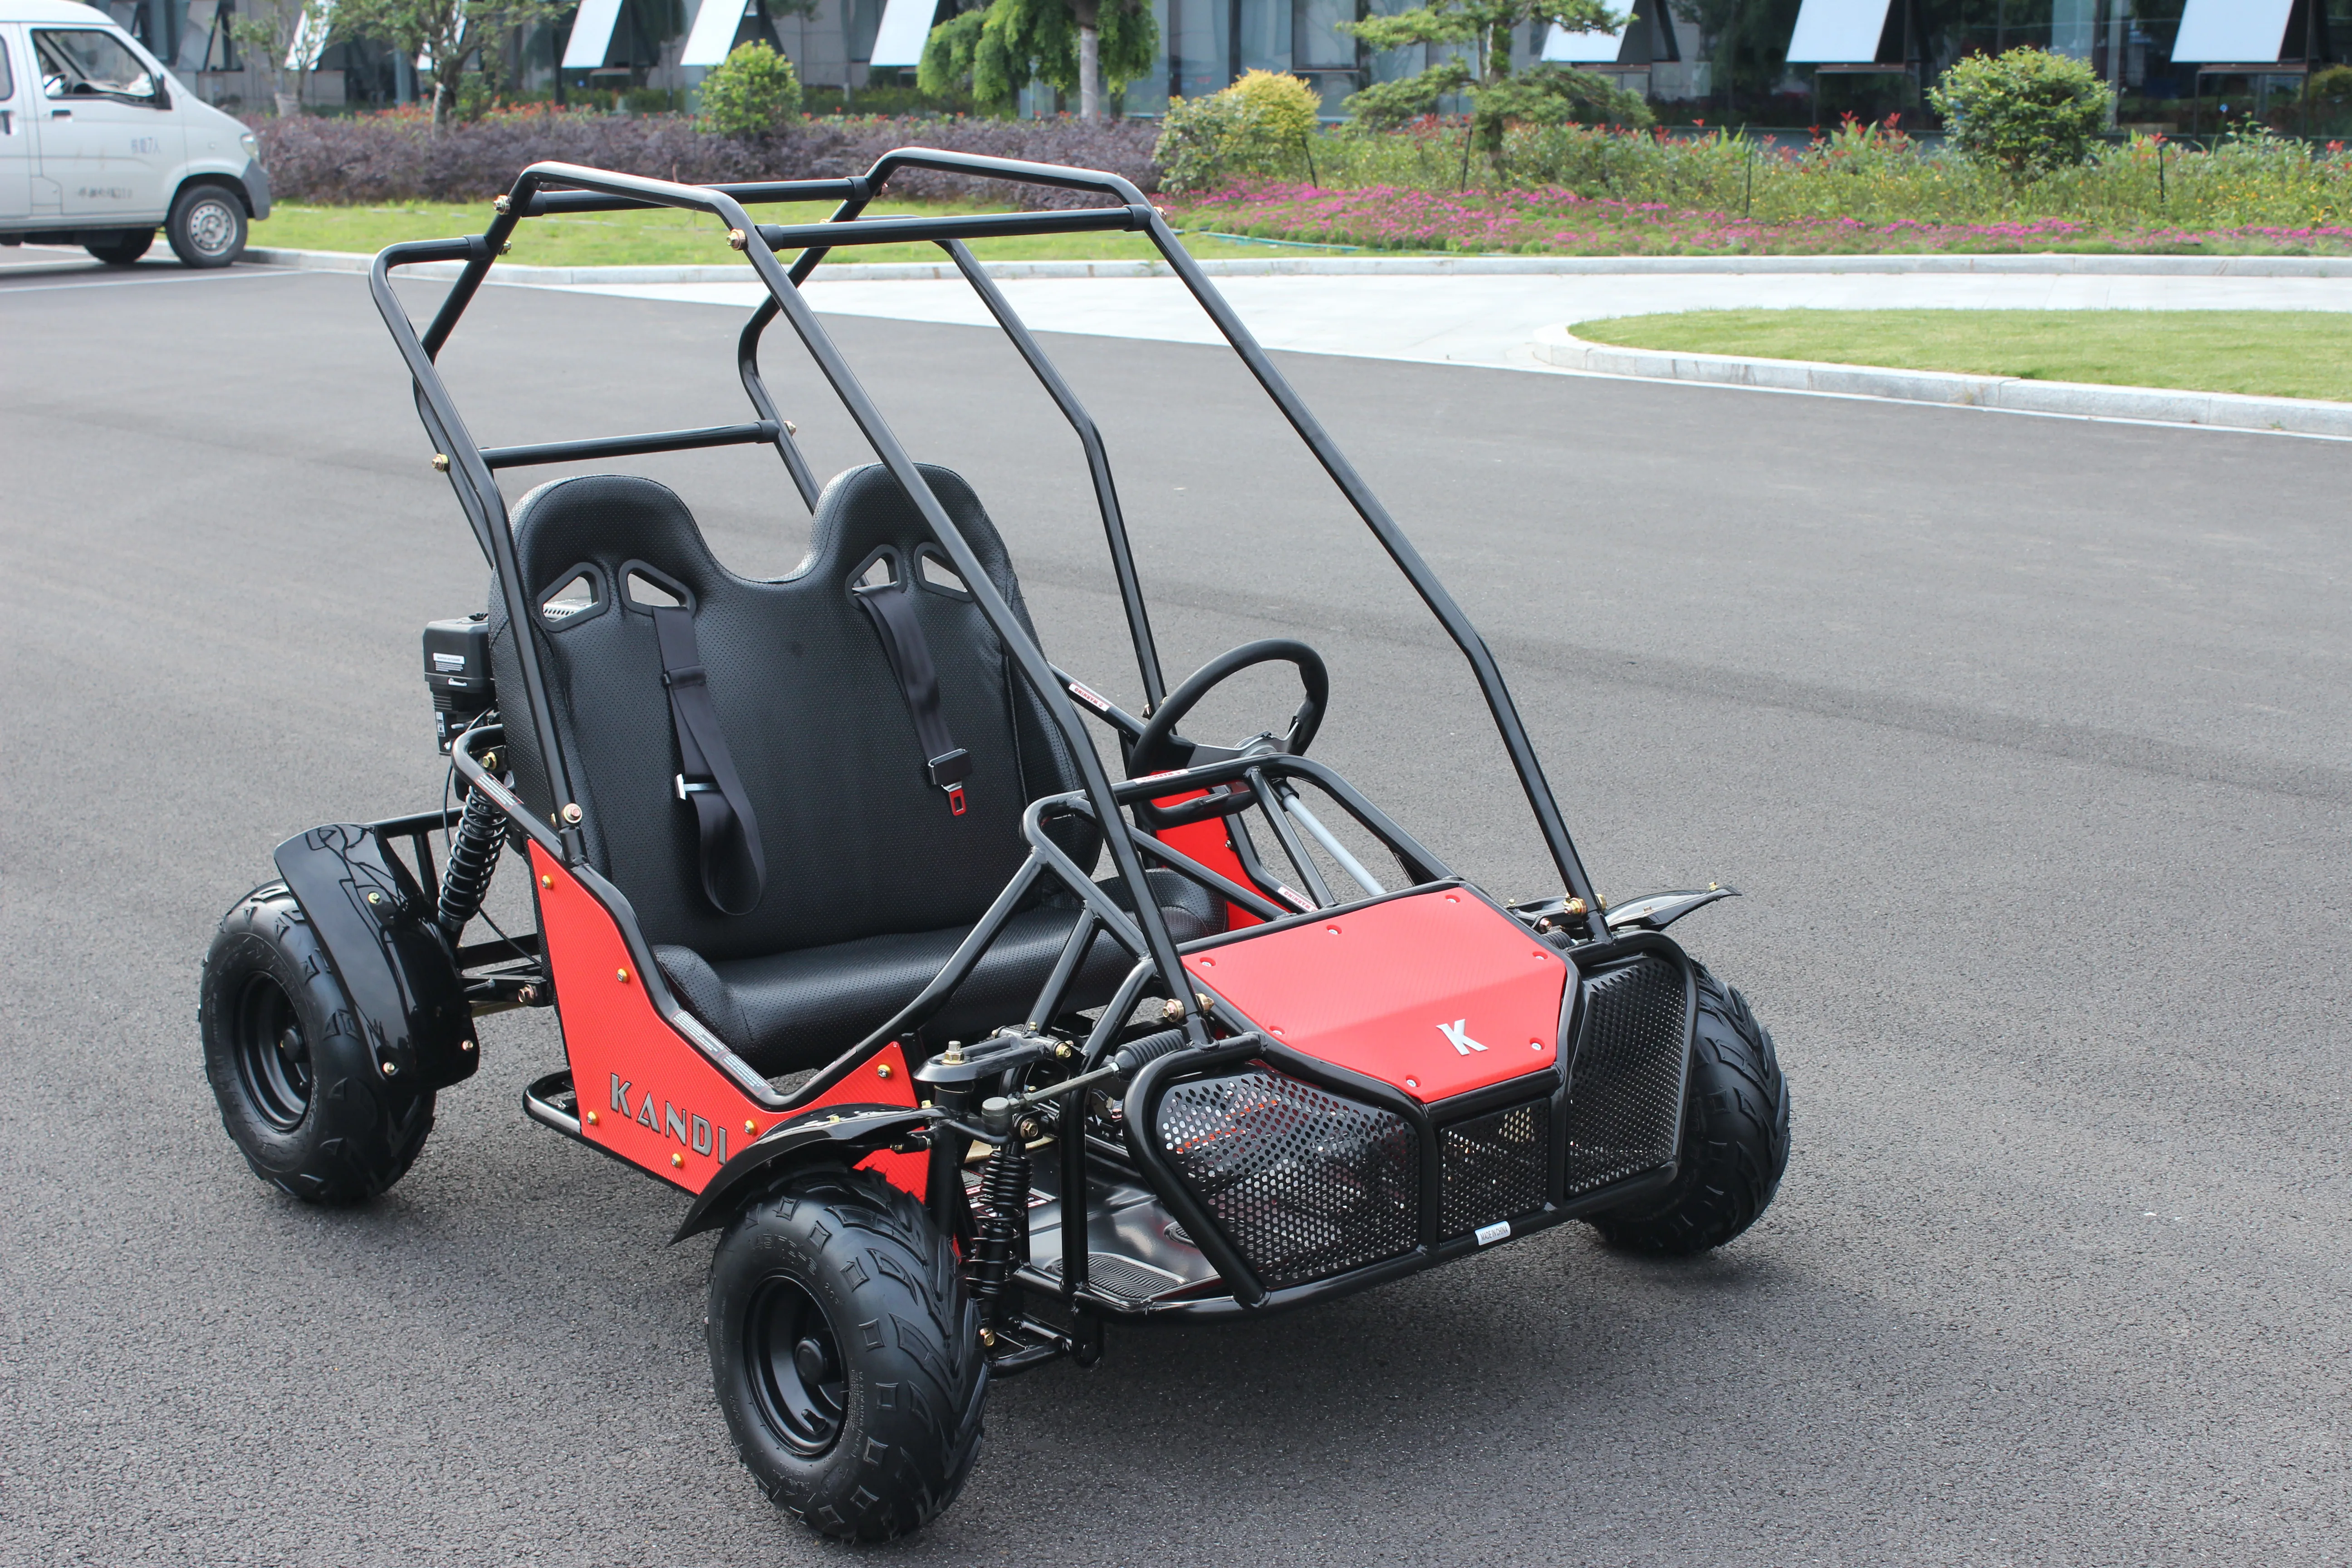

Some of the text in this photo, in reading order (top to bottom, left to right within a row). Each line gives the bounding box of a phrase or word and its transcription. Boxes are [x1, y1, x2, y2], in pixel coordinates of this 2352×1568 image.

[1074, 687, 1098, 704] WARNING
[1284, 891, 1311, 909] WARNING
[1436, 1019, 1489, 1056] K
[611, 1073, 726, 1166] KANDI
[1480, 1225, 1509, 1240] MADE IN CHINA
